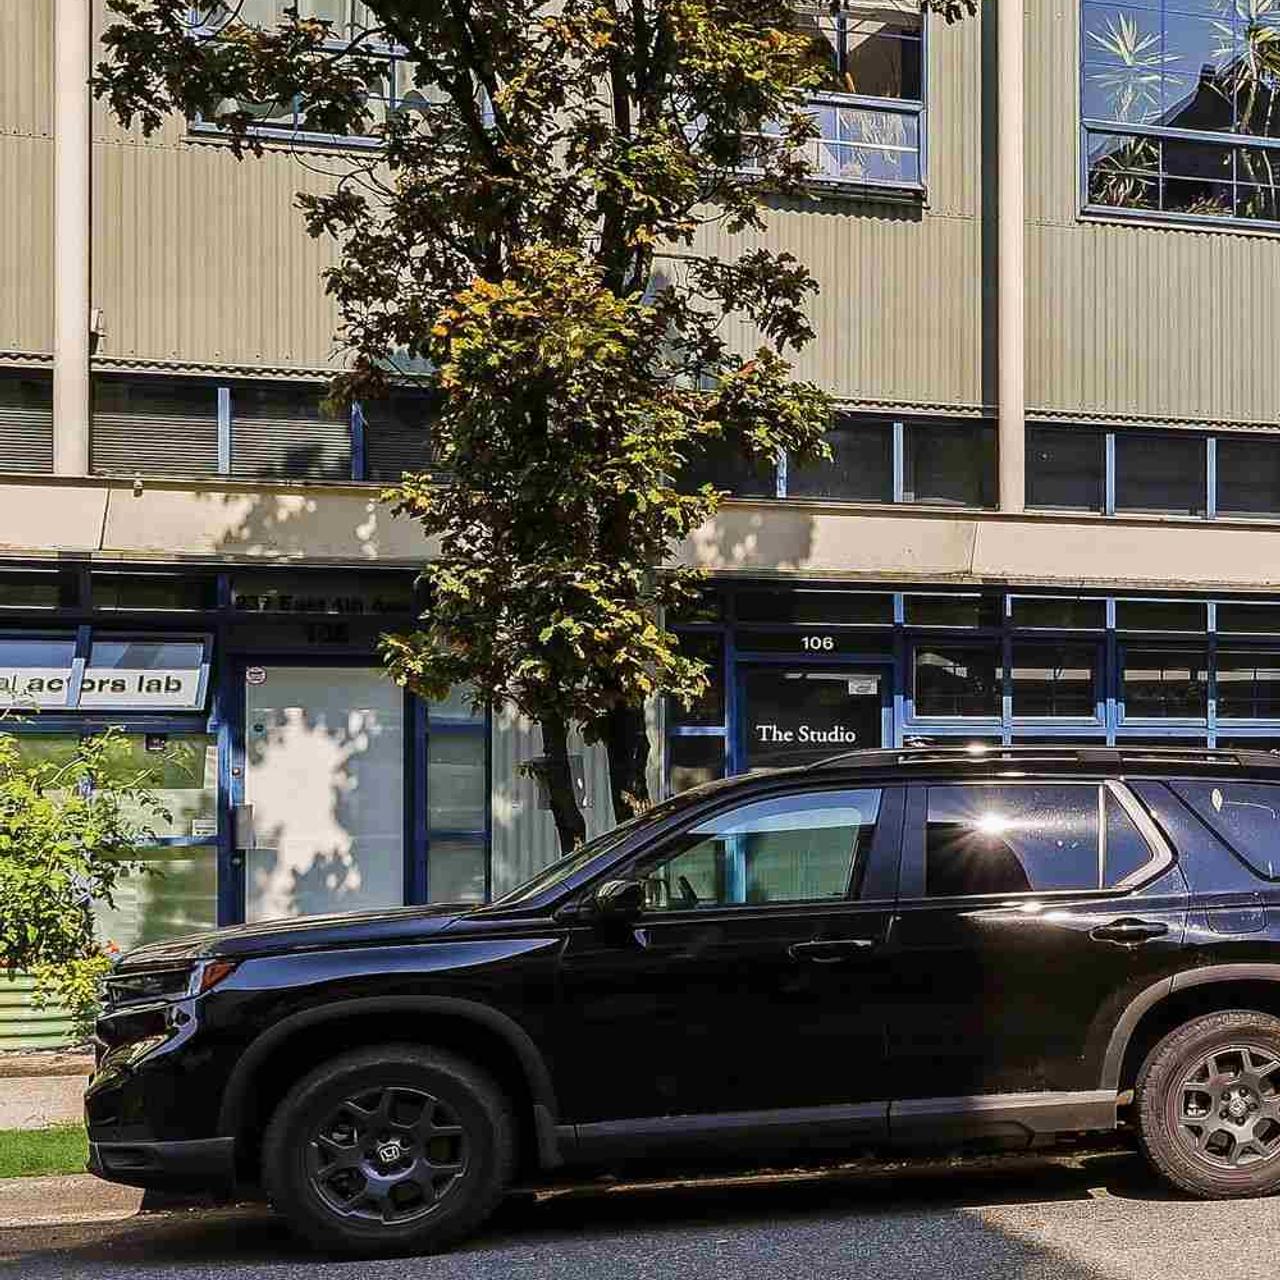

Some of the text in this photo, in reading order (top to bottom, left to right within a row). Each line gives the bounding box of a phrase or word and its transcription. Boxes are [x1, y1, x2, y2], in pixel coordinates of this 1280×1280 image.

[801, 636, 834, 650] 106
[138, 675, 182, 693] lab
[756, 724, 856, 742] The Studio
